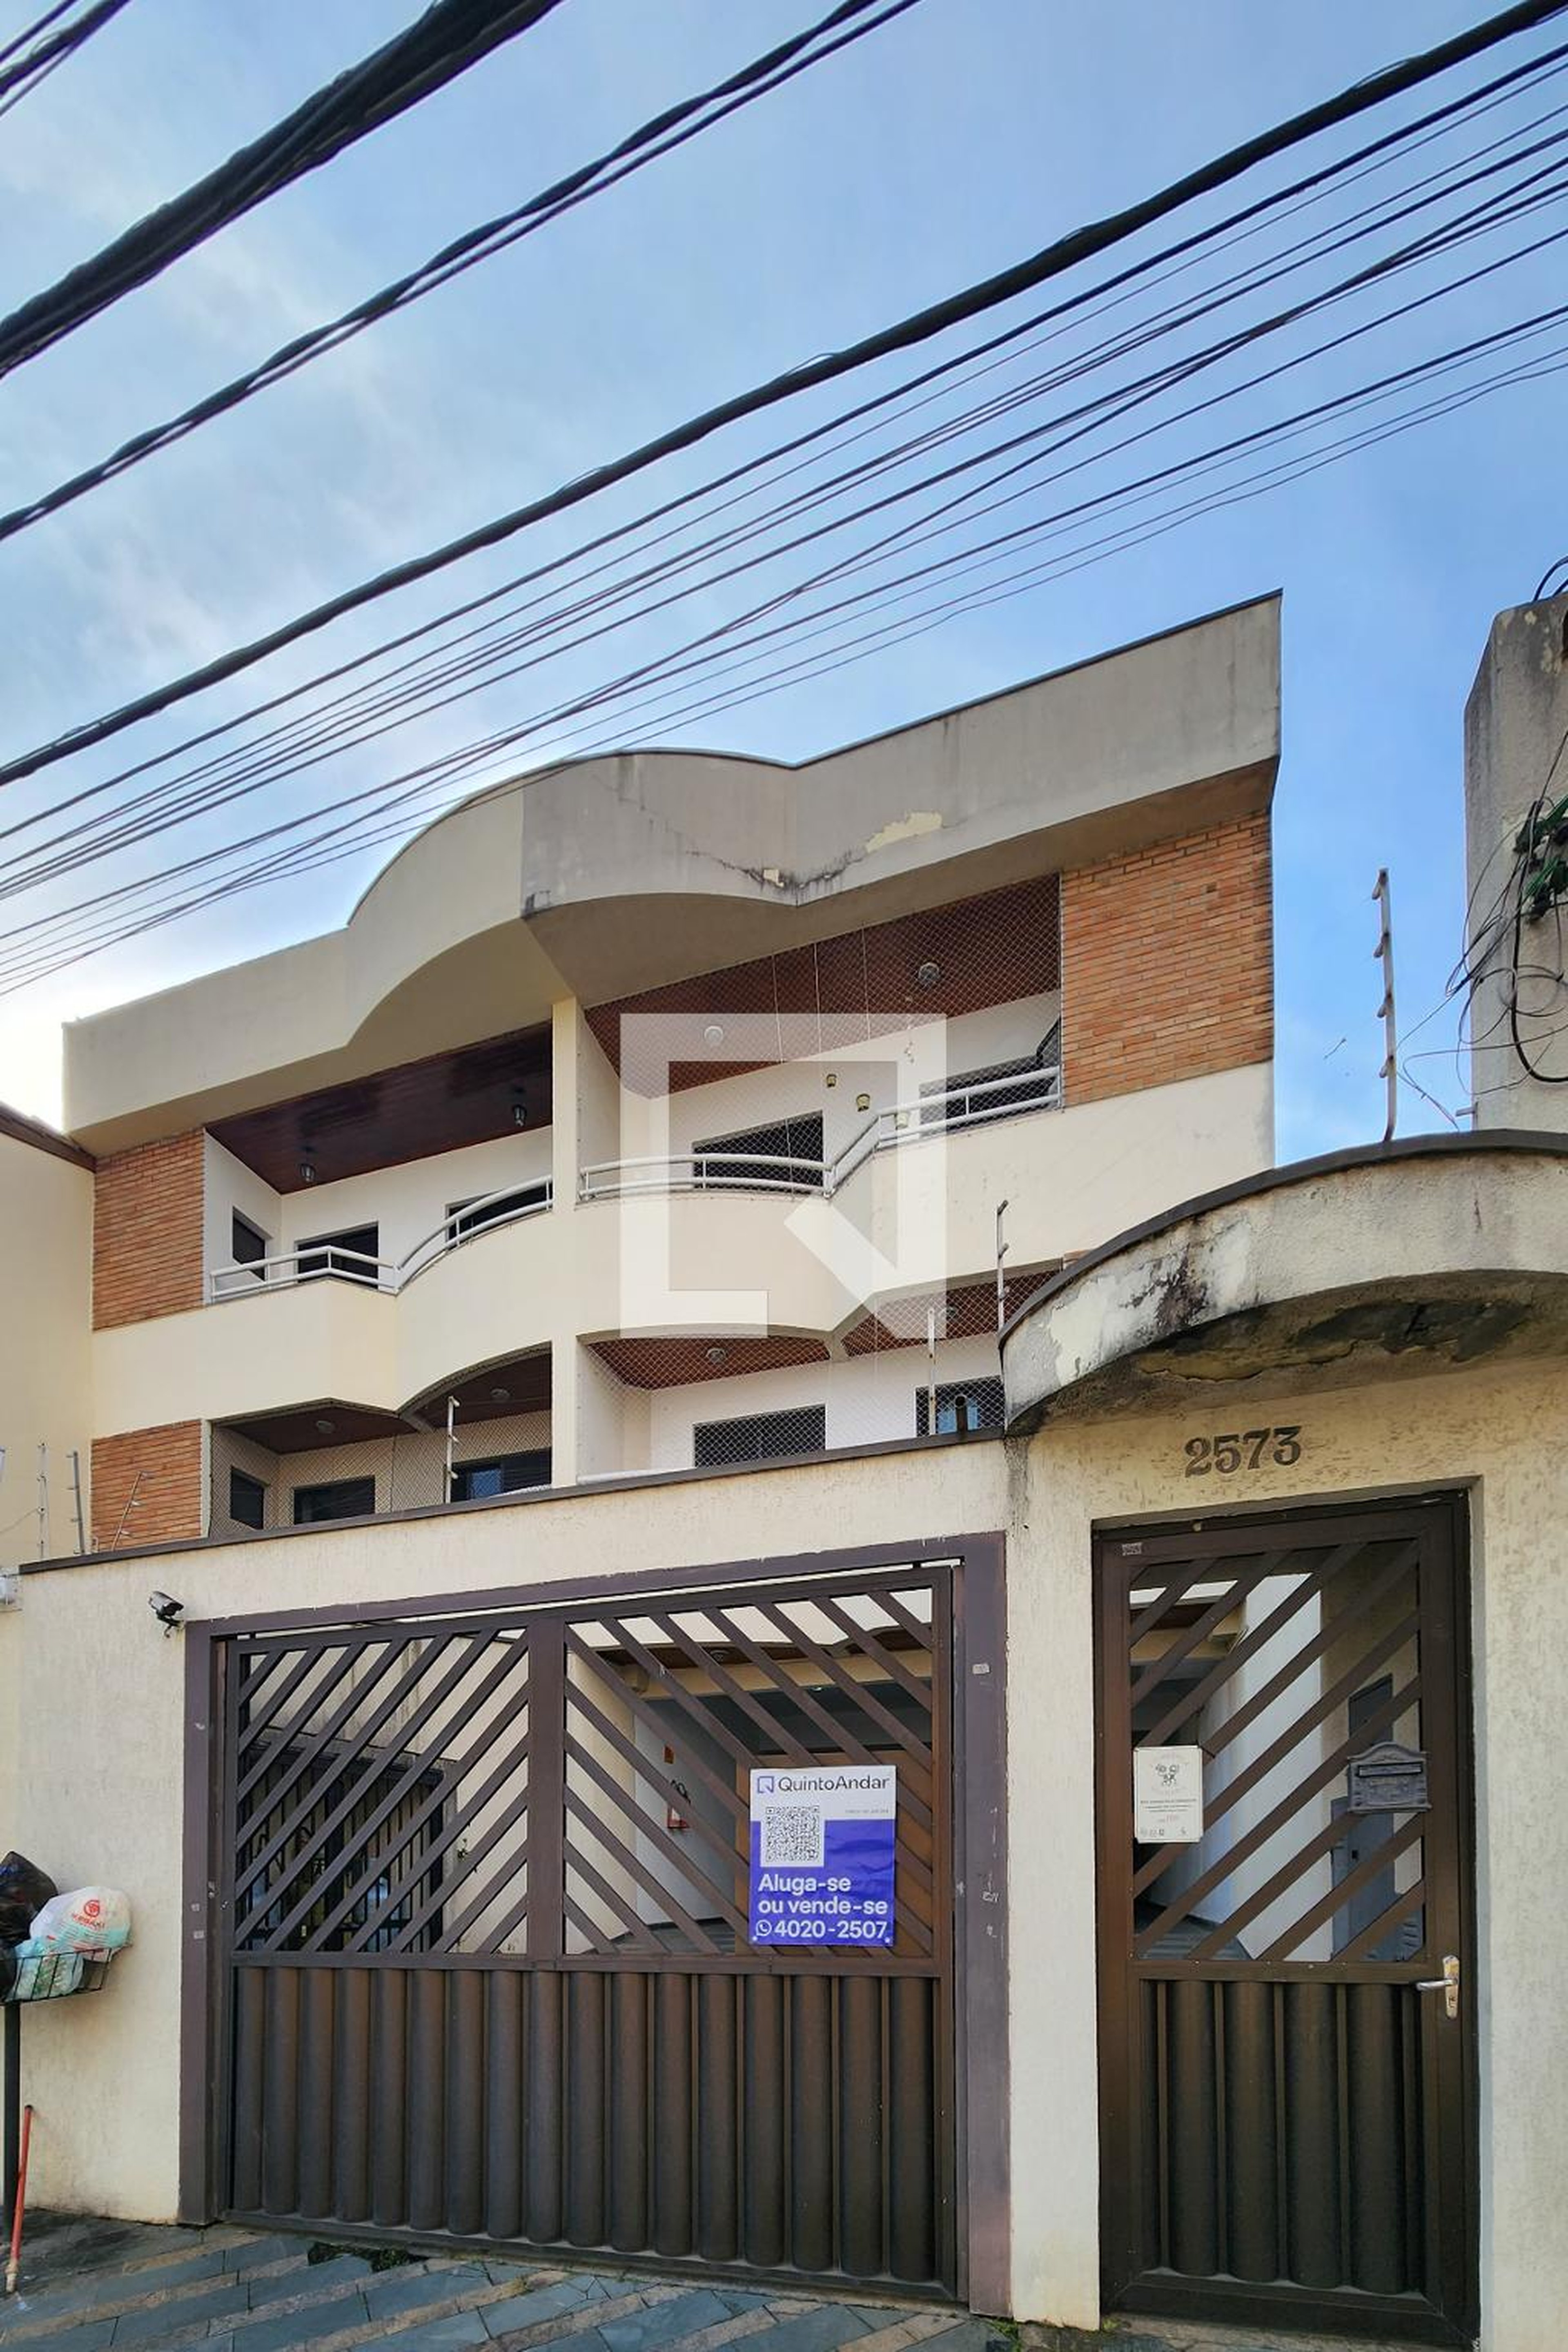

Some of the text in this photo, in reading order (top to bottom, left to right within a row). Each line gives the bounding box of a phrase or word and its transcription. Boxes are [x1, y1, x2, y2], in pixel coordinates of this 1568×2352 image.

[1184, 1425, 1302, 1477] 2573
[778, 1776, 889, 1791] QuintoAndar
[758, 1873, 851, 1895] Aluga-se
[758, 1896, 888, 1914] ou vende-se
[774, 1920, 887, 1939] 4020-2507
